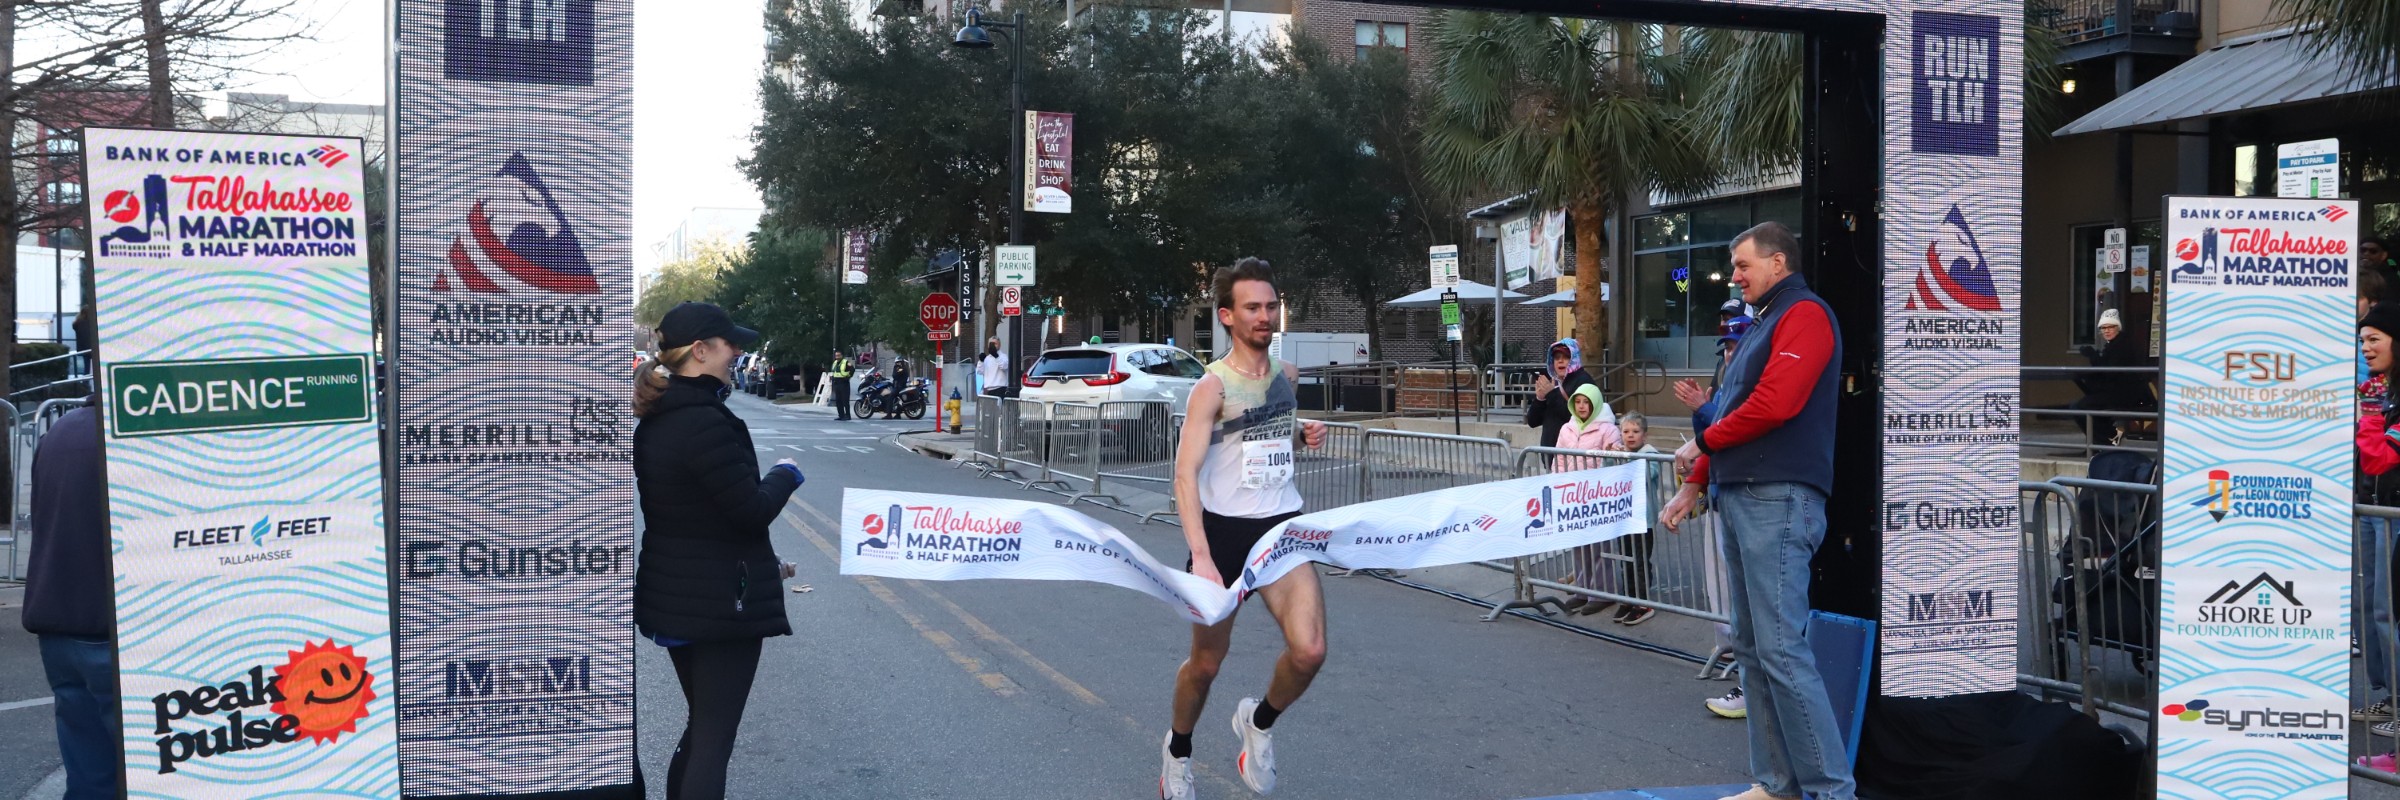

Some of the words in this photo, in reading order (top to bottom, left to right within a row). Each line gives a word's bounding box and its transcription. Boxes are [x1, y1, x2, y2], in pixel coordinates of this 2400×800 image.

[1924, 34, 1989, 78] RUN
[1927, 79, 1984, 123] TLH
[1039, 118, 1054, 129] Live
[1054, 117, 1064, 127] the
[1037, 126, 1068, 143] Lifestyle!
[106, 146, 170, 163] BANK
[176, 148, 203, 163] OF
[209, 149, 307, 167] AMERICA
[1045, 143, 1060, 152] EAT
[1039, 159, 1065, 168] DRINK
[1040, 175, 1064, 185] SHOP
[170, 175, 353, 216] Tallahassee
[2180, 208, 2221, 219] BANK
[2225, 209, 2244, 220] OF
[2247, 209, 2317, 222] AMERICA
[179, 216, 355, 240] MARATHON
[1510, 219, 1529, 234] VALE
[2111, 233, 2119, 243] NO
[2220, 227, 2348, 256] Tallahassee
[181, 243, 195, 257] &
[200, 243, 249, 257] HALF
[254, 242, 356, 257] MARATHON
[1001, 252, 1029, 260] PUBLIC
[999, 262, 1032, 271] PARKING
[1671, 267, 1688, 280] OPE
[2223, 256, 2348, 275] MARATHON
[962, 248, 971, 320] YSSEY
[2223, 275, 2233, 285] &
[2236, 275, 2270, 286] HALF
[2273, 276, 2348, 287] MARATHON
[429, 304, 603, 325] AMERICAN
[923, 305, 956, 320] STOP
[1905, 318, 2003, 335] AMERICAN
[429, 328, 508, 346] AUDIO
[513, 329, 602, 346] VISUAL
[1905, 338, 1948, 349] AUDIO
[1951, 339, 2002, 350] VISUAL
[2223, 350, 2296, 382] FSU
[123, 377, 306, 417] CADENCE
[306, 374, 358, 386] RUNNING
[2180, 386, 2255, 401] INSTITUTE
[2259, 387, 2278, 402] OF
[2283, 388, 2338, 403] SPORTS
[2178, 402, 2247, 418] SCIENCES
[2251, 406, 2262, 418] &
[2266, 405, 2341, 420] MEDICINE
[1887, 413, 1979, 430] MERRILL
[405, 425, 563, 448] MERRILL
[1243, 433, 1270, 441] ELITE
[1273, 430, 1292, 438] TEAM
[1268, 452, 1291, 466] 1004
[2233, 475, 2312, 489] FOUNDATION
[1554, 479, 1633, 505] Tallahassee
[2232, 492, 2245, 500] for
[2245, 489, 2271, 501] LEON
[2273, 490, 2312, 502] COUNTY
[1557, 495, 1633, 522] MARATHON
[1915, 499, 2016, 530] Gunster
[2233, 502, 2312, 520] SCHOOLS
[905, 504, 1023, 535] Tallahassee
[1557, 524, 1564, 533] &
[1566, 520, 1589, 532] HALF
[1590, 510, 1633, 527] MARATHON
[173, 525, 245, 549] FLEET
[276, 516, 332, 538] FEET
[1355, 536, 1393, 545] BANK
[1397, 533, 1413, 544] OF
[1416, 523, 1470, 541] AMERICA
[906, 533, 1021, 552] MARATHON
[1054, 539, 1098, 554] BANK
[1102, 547, 1120, 559] OF
[218, 549, 293, 566] TALLAHASSEE
[459, 540, 629, 578] Gunster
[906, 551, 914, 561] &
[918, 551, 949, 562] HALF
[952, 551, 1020, 564] MARATHON
[1908, 590, 1992, 621] MSM
[2198, 605, 2275, 625] SHORE
[2282, 607, 2312, 625] UP
[2178, 624, 2279, 639] FOUNDATION
[2284, 626, 2335, 640] REPAIR
[446, 656, 590, 698] MSM
[151, 665, 287, 735] peak
[2204, 707, 2344, 731] syntech
[157, 711, 301, 774] pulse
[2277, 732, 2344, 741] FUELMASTER
